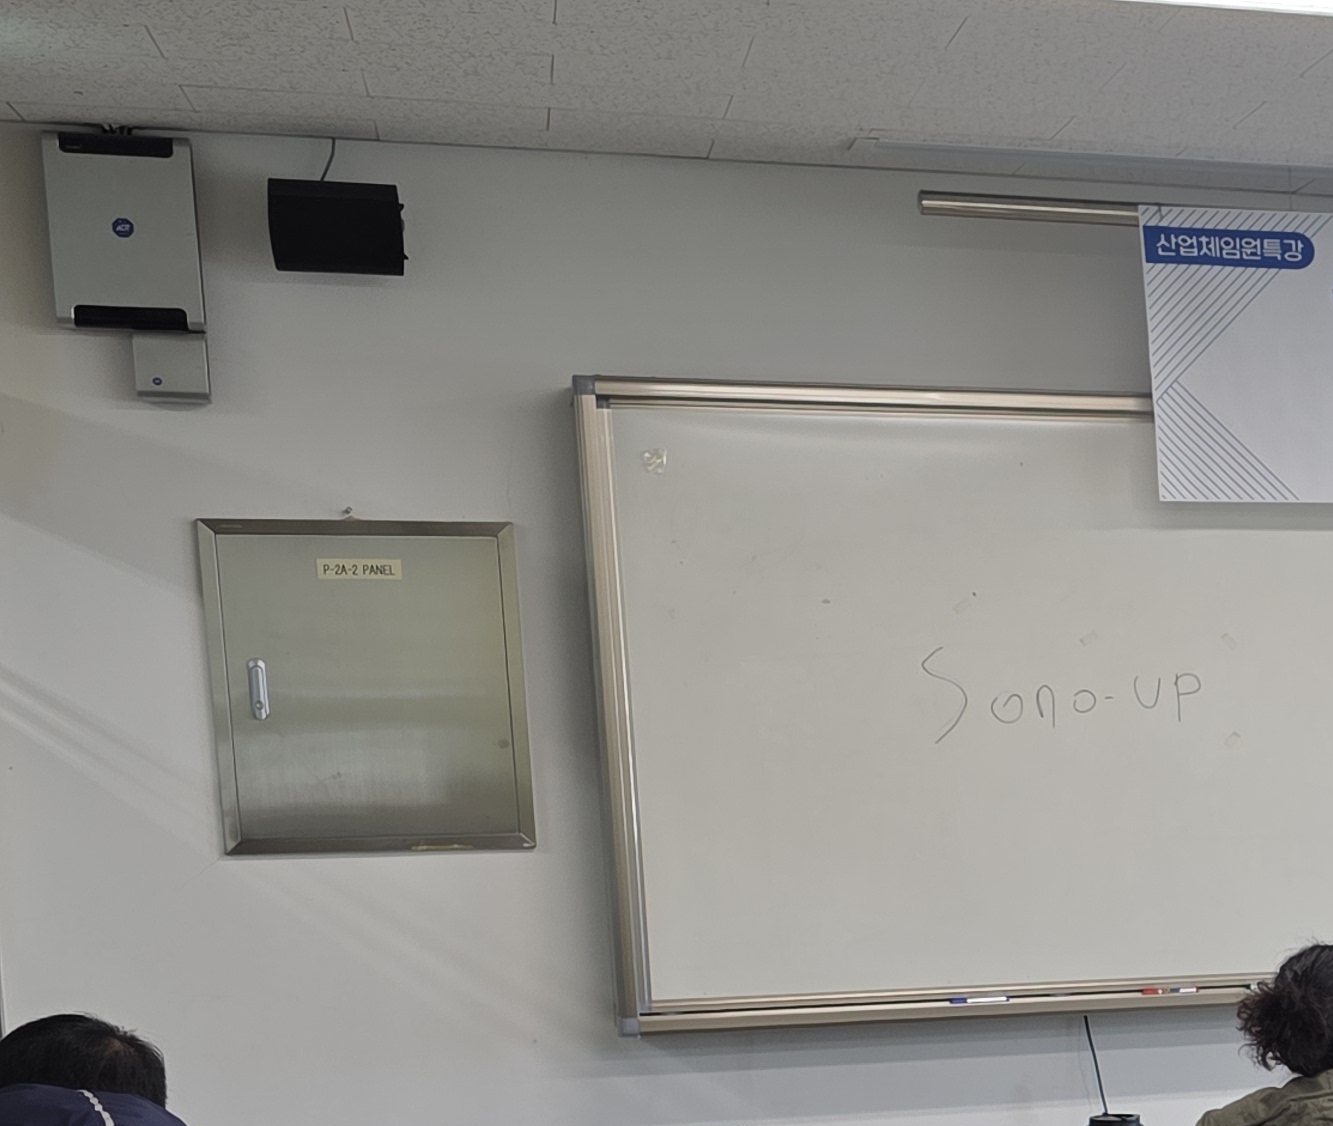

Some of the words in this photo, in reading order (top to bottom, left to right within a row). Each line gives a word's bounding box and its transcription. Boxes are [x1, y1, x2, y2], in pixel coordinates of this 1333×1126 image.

[1156, 233, 1305, 262] 산업체임원특강
[322, 563, 359, 577] P-2A-2
[362, 563, 396, 577] PANEL
